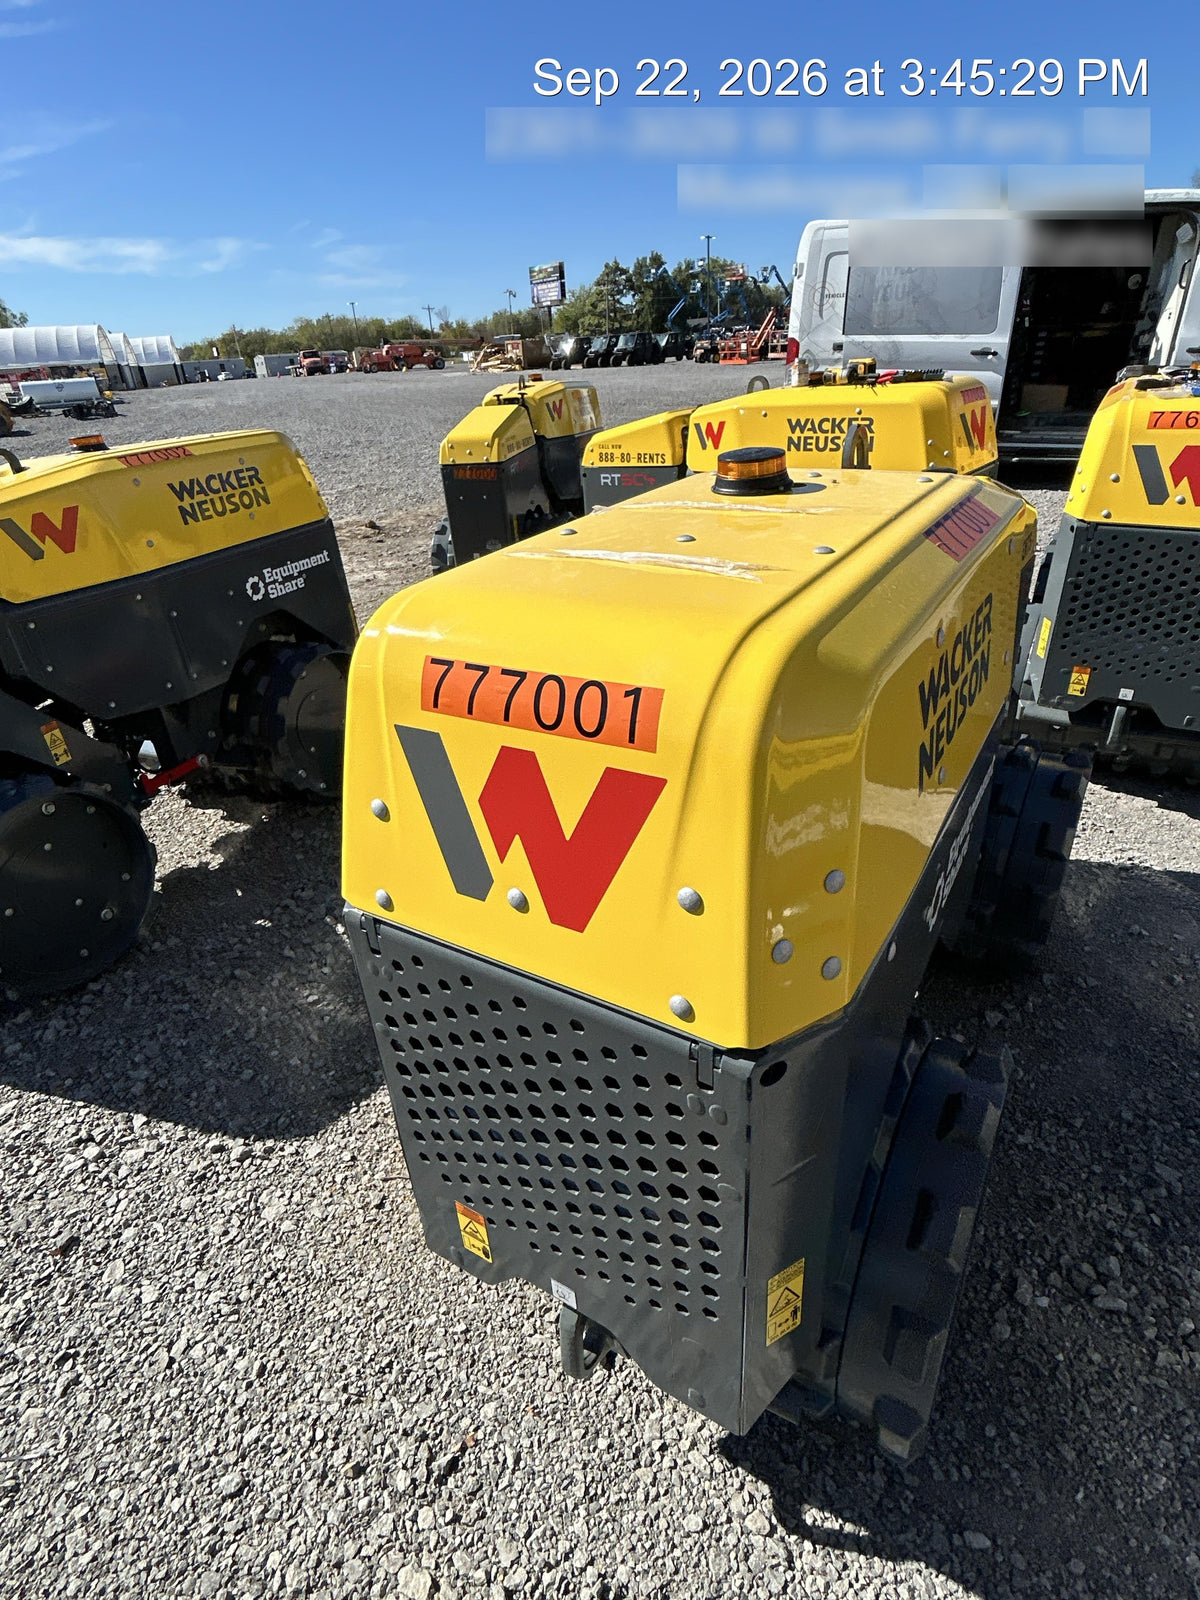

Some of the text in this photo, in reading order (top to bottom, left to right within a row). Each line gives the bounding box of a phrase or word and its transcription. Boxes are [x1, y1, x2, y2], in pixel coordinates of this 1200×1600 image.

[598, 452, 666, 464] 888-80-RENTS
[786, 435, 875, 452] NEUS
[167, 466, 264, 502] WACKER
[178, 486, 271, 526] NEUSON
[263, 550, 330, 583] Equipment
[267, 577, 306, 599] Share
[919, 592, 993, 731] WACKER
[430, 657, 644, 746] 777001
[919, 639, 991, 797] NEUSON
